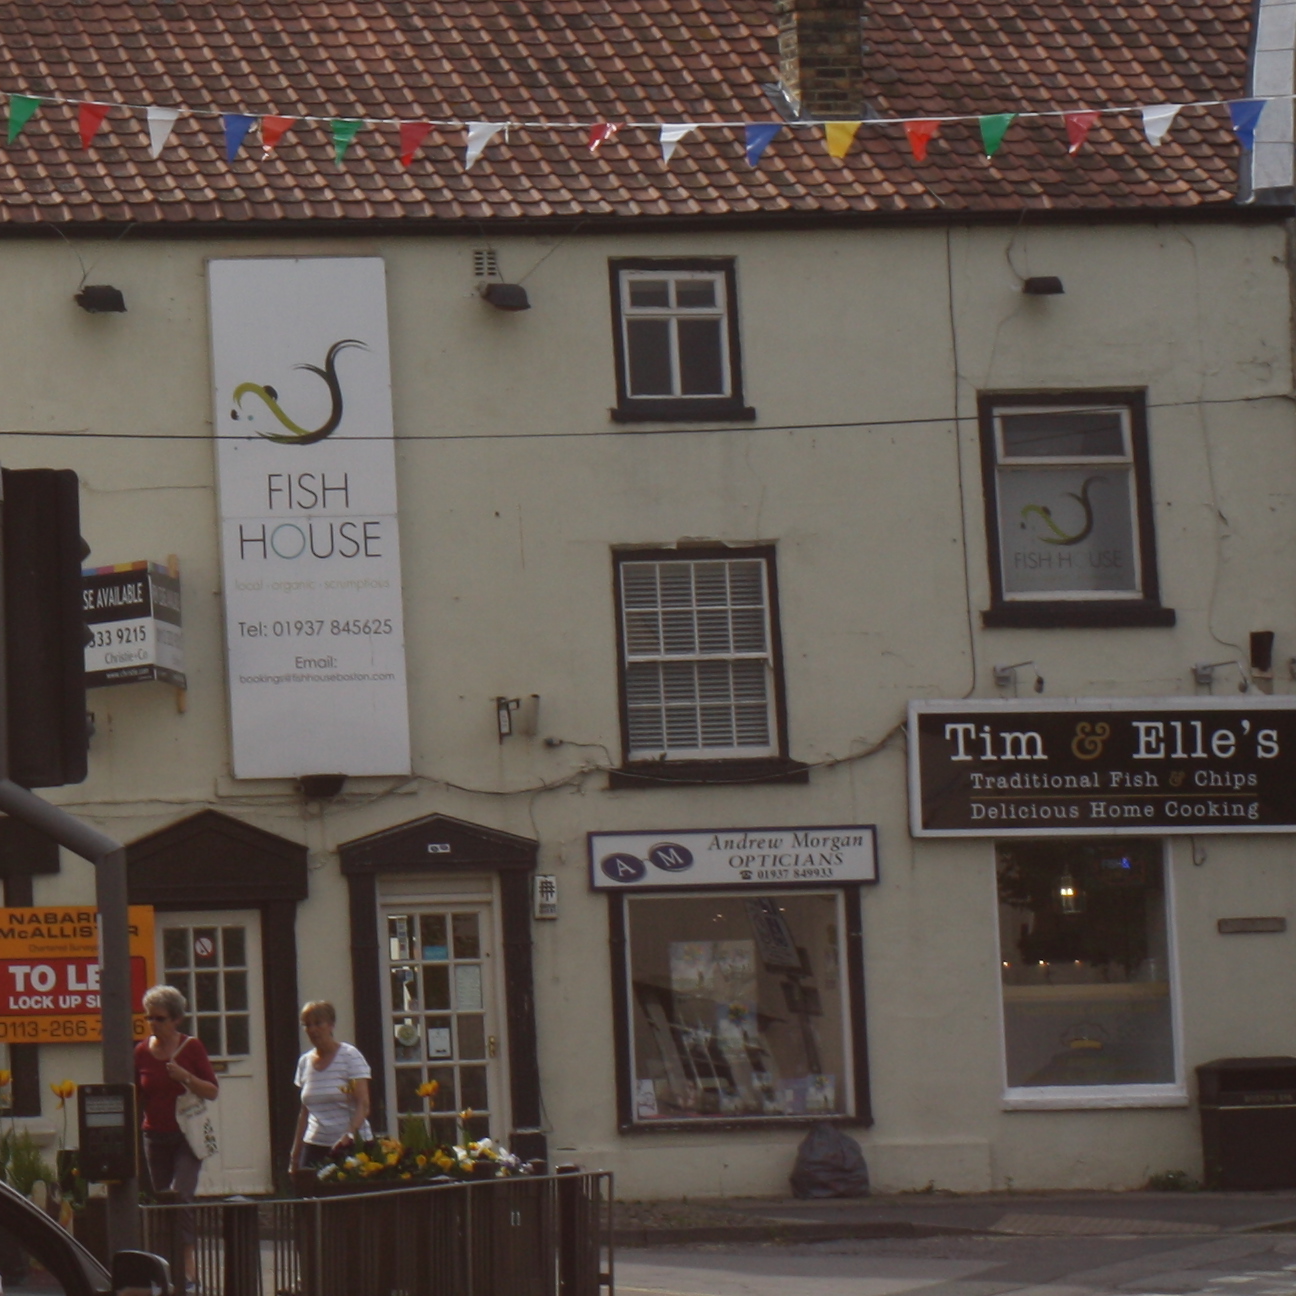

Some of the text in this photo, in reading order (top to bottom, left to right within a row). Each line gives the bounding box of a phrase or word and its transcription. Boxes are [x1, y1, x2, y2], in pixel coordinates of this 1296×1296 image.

[268, 473, 349, 510] FISH
[239, 521, 383, 560] HOUSE
[1014, 550, 1123, 569] FISH HUSE
[95, 581, 144, 609] AVAILABLE
[235, 578, 390, 594] local organic scrumptious
[116, 624, 146, 644] 9215
[238, 618, 393, 638] Tel: 01937 845625
[295, 656, 338, 670] Email:
[944, 719, 1280, 762] Tim & Elle's
[970, 769, 1259, 790] Traditional Fish & Chips
[970, 800, 1260, 821] Delicious Home Cooking
[707, 832, 864, 852] Andrew Morgan
[616, 847, 684, 877] A M
[728, 851, 844, 869] OPTICIANS
[756, 868, 790, 880] 01937
[9, 912, 99, 925] NABAR
[8, 964, 101, 992] TO LE
[9, 995, 55, 1010] LOCK
[58, 994, 82, 1009] UP
